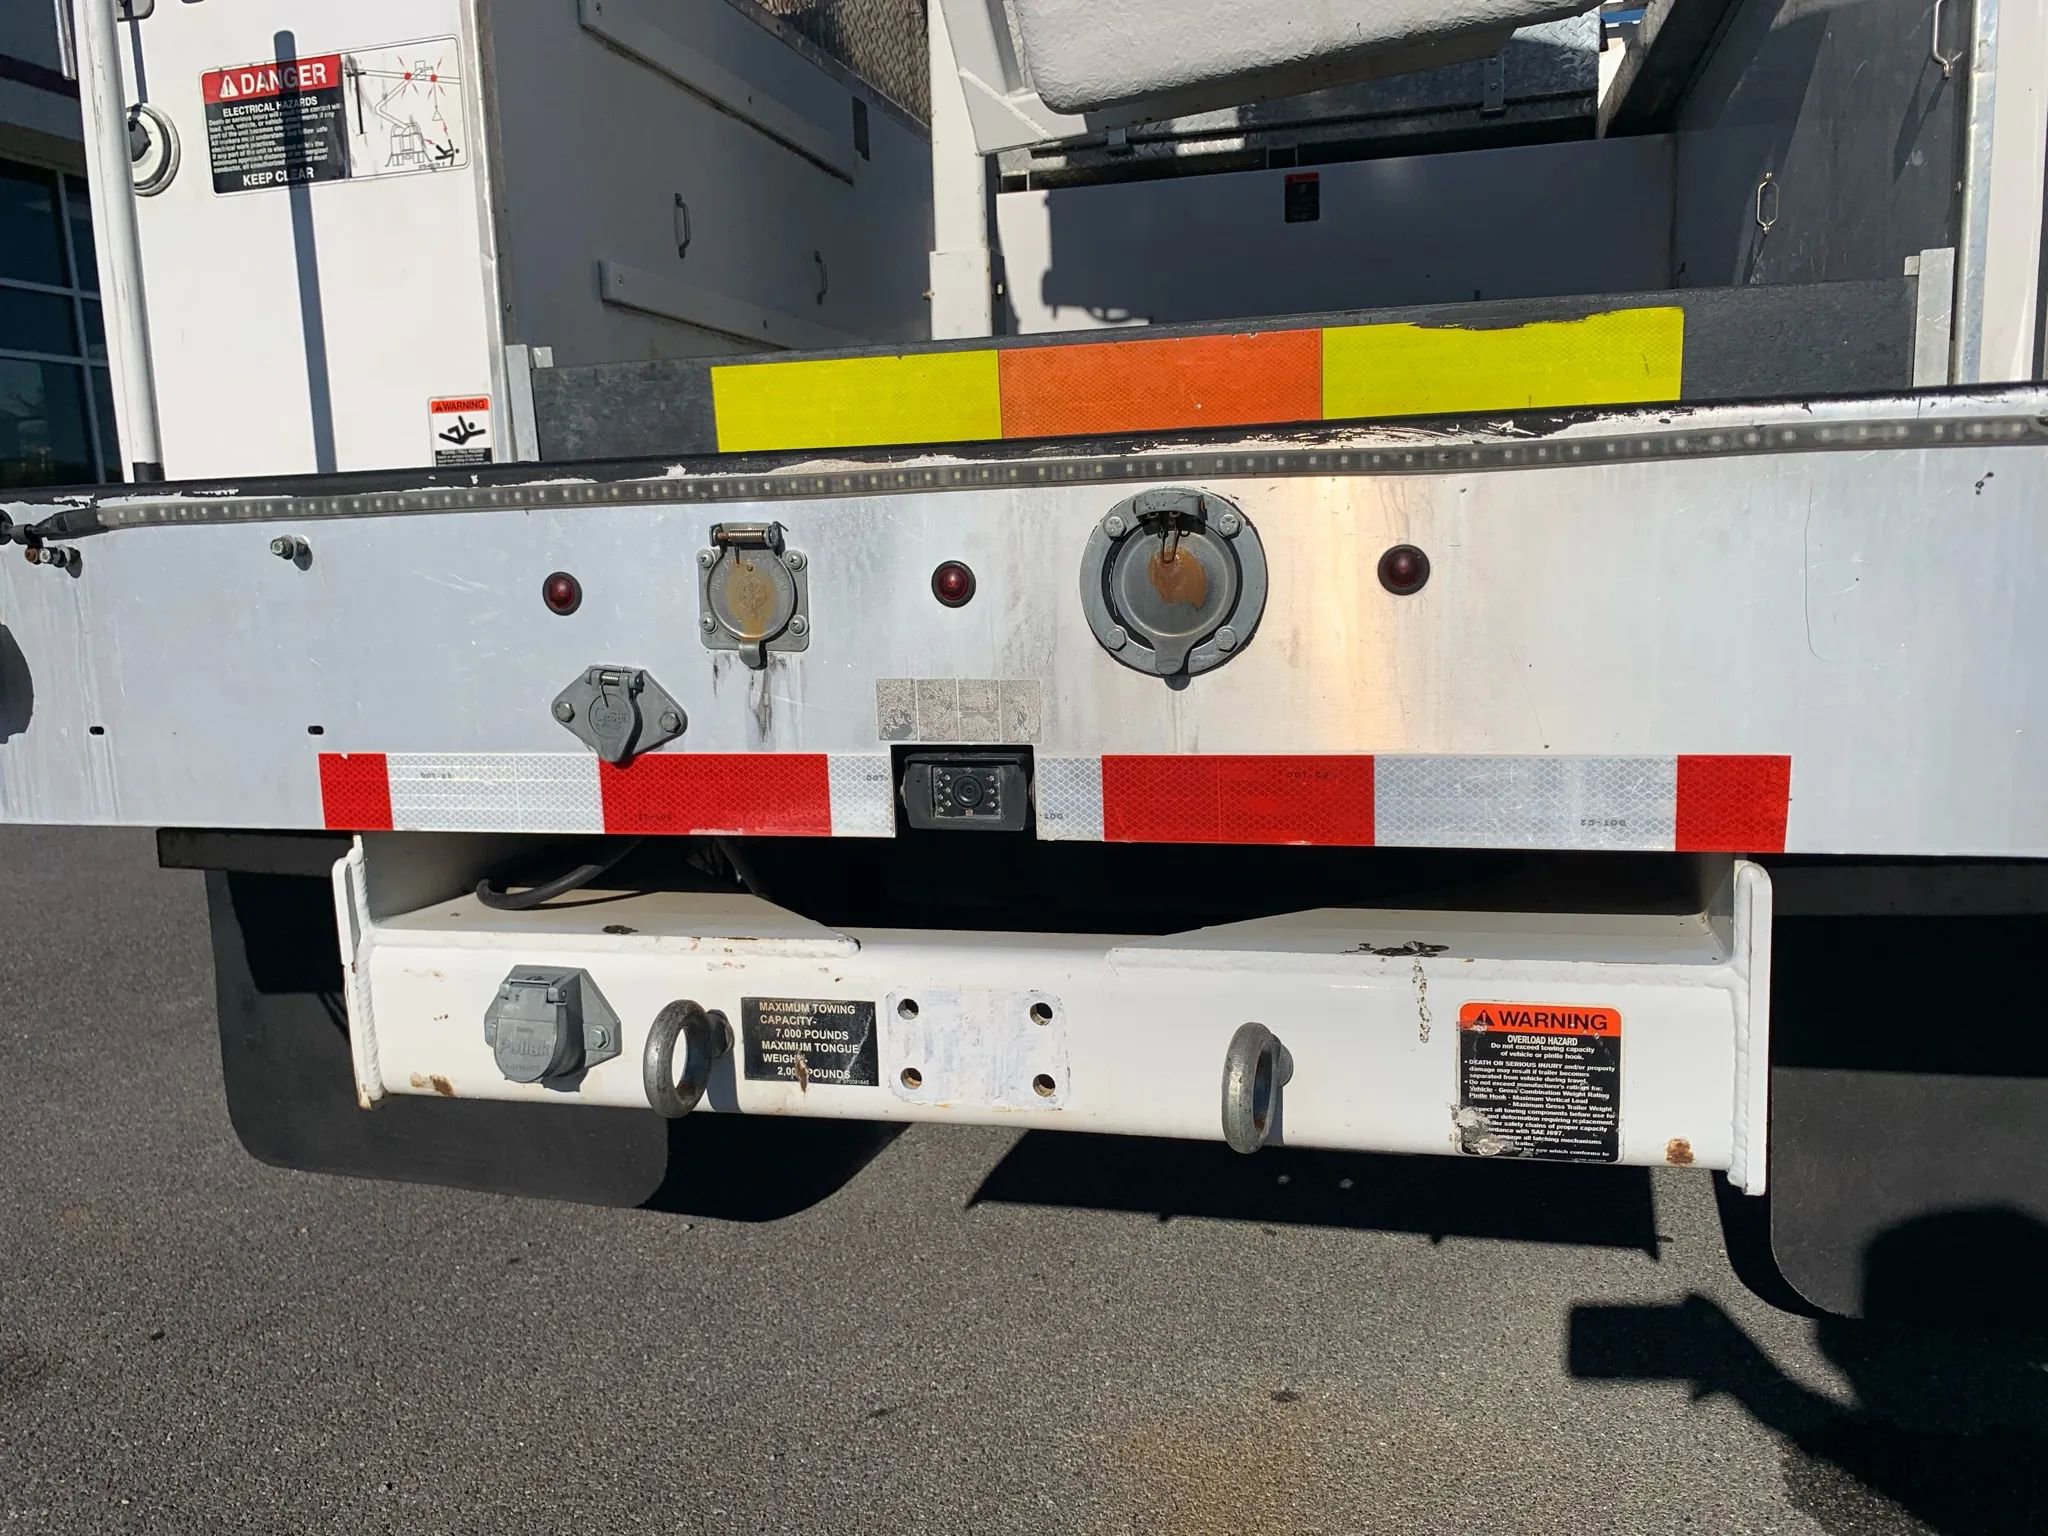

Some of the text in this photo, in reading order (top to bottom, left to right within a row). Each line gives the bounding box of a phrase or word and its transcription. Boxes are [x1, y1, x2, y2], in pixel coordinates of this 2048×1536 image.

[240, 62, 327, 95] DANGER
[222, 103, 275, 117] ELECTRICAL
[276, 96, 318, 110] HAZARDS
[242, 166, 314, 186] KEEP CLEAR
[442, 400, 485, 411] WARNING
[760, 1002, 856, 1014] MAXIMUM TOWING
[1498, 1010, 1608, 1030] WARNING
[776, 1028, 849, 1040] 7,000 POUNDS
[1508, 1034, 1578, 1046] OVERLOAD HAZARD
[762, 1040, 860, 1054] MAXIMUM TONGUE
[1566, 1046, 1595, 1054] capacity
[808, 1069, 851, 1078] POUNDS
[1520, 1088, 1560, 1096] Combination
[1562, 1090, 1586, 1098] Weight
[1588, 1092, 1610, 1100] Rating
